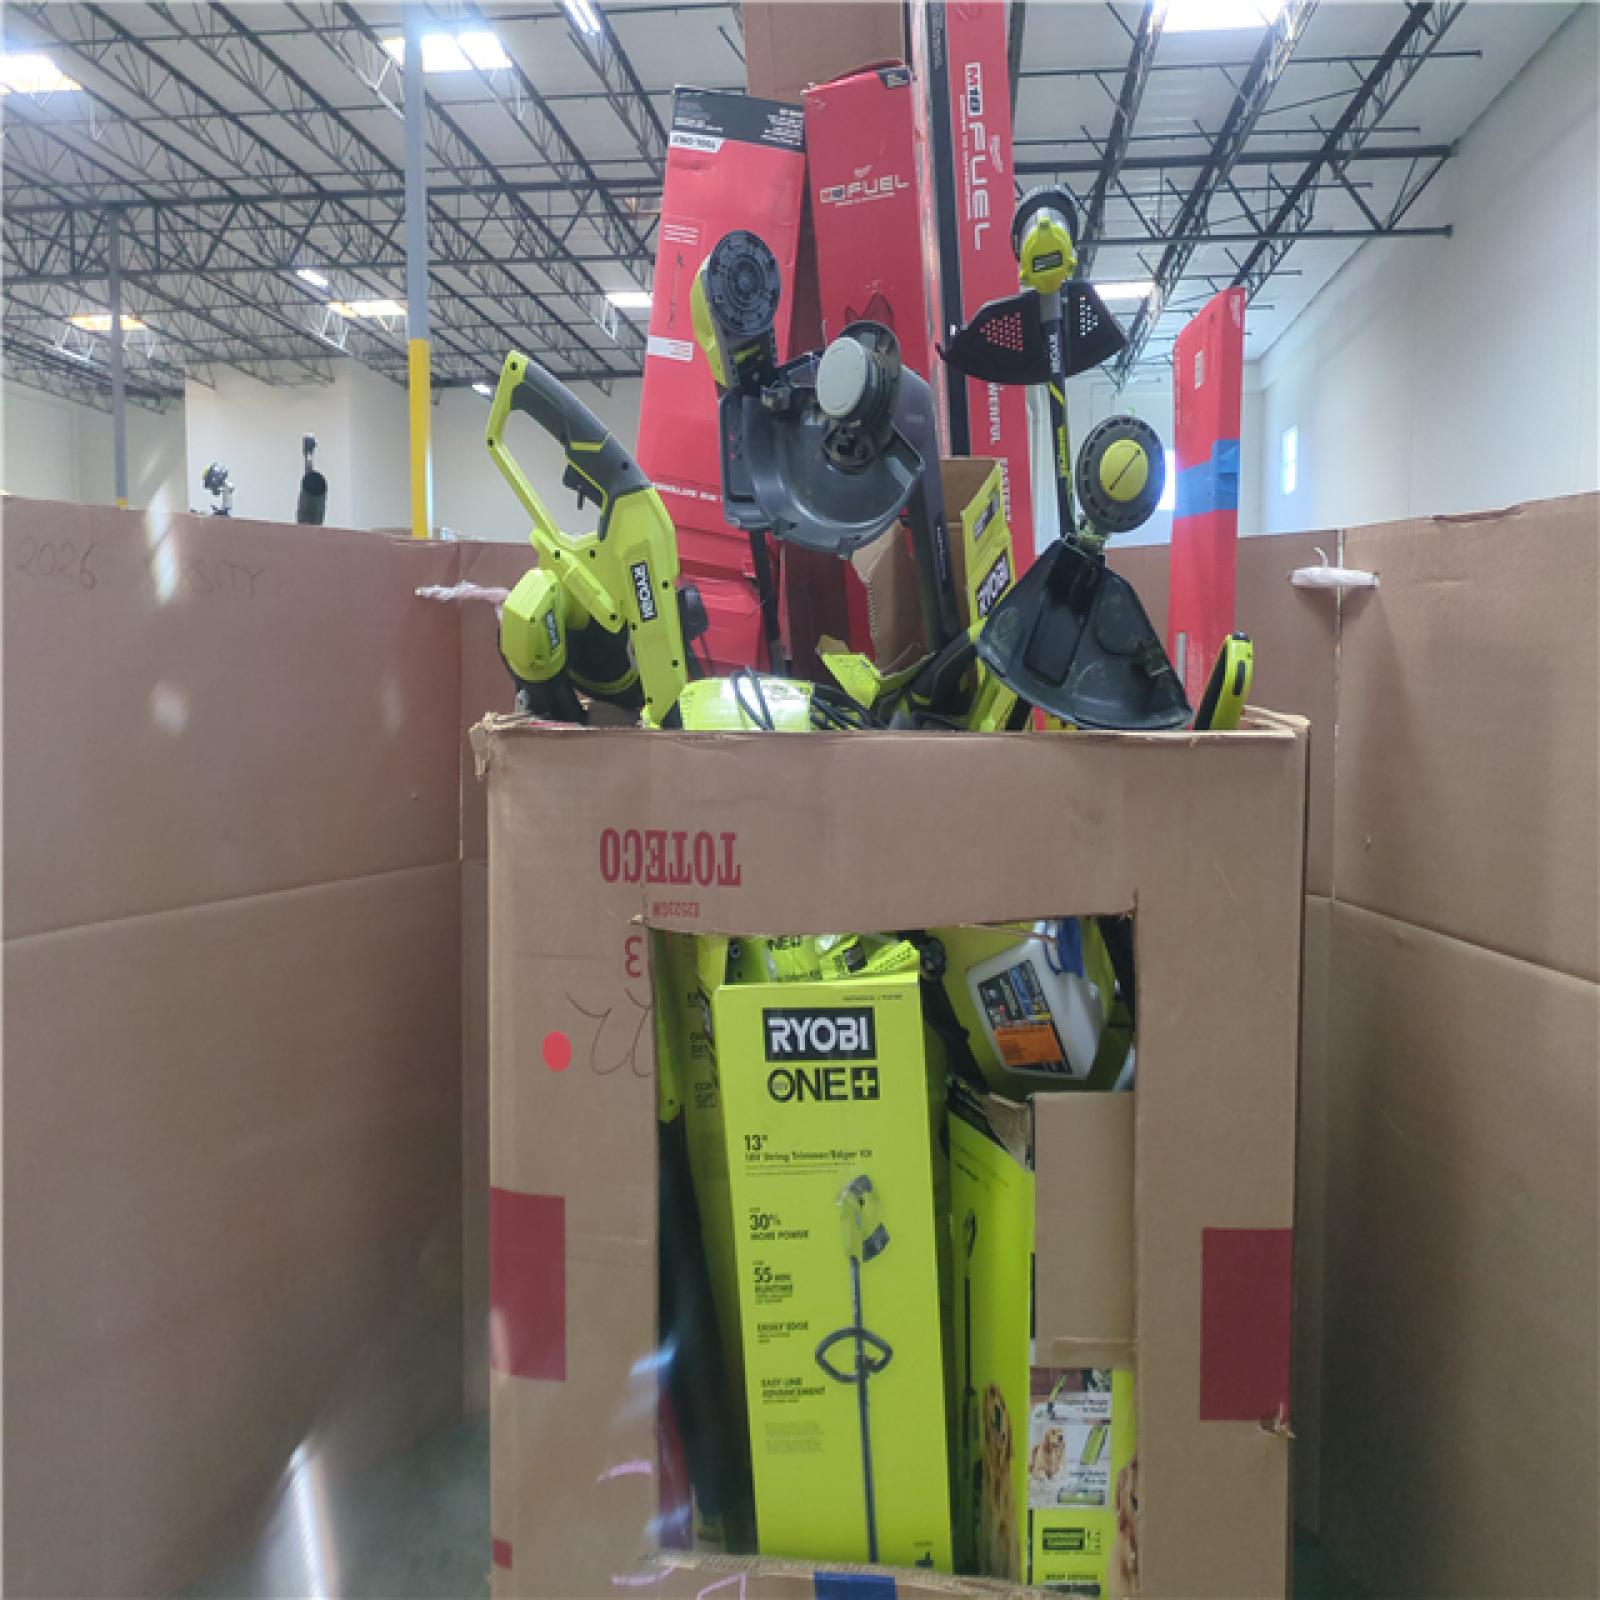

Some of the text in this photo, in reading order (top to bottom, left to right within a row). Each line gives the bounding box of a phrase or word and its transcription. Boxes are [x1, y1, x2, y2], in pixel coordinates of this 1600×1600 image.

[846, 175, 909, 198] FUEL
[970, 122, 990, 250] FUEL
[600, 827, 742, 888] TOTECO
[767, 1015, 870, 1055] RYOBI
[767, 1066, 880, 1103] ONE+
[754, 1267, 773, 1284] 55
